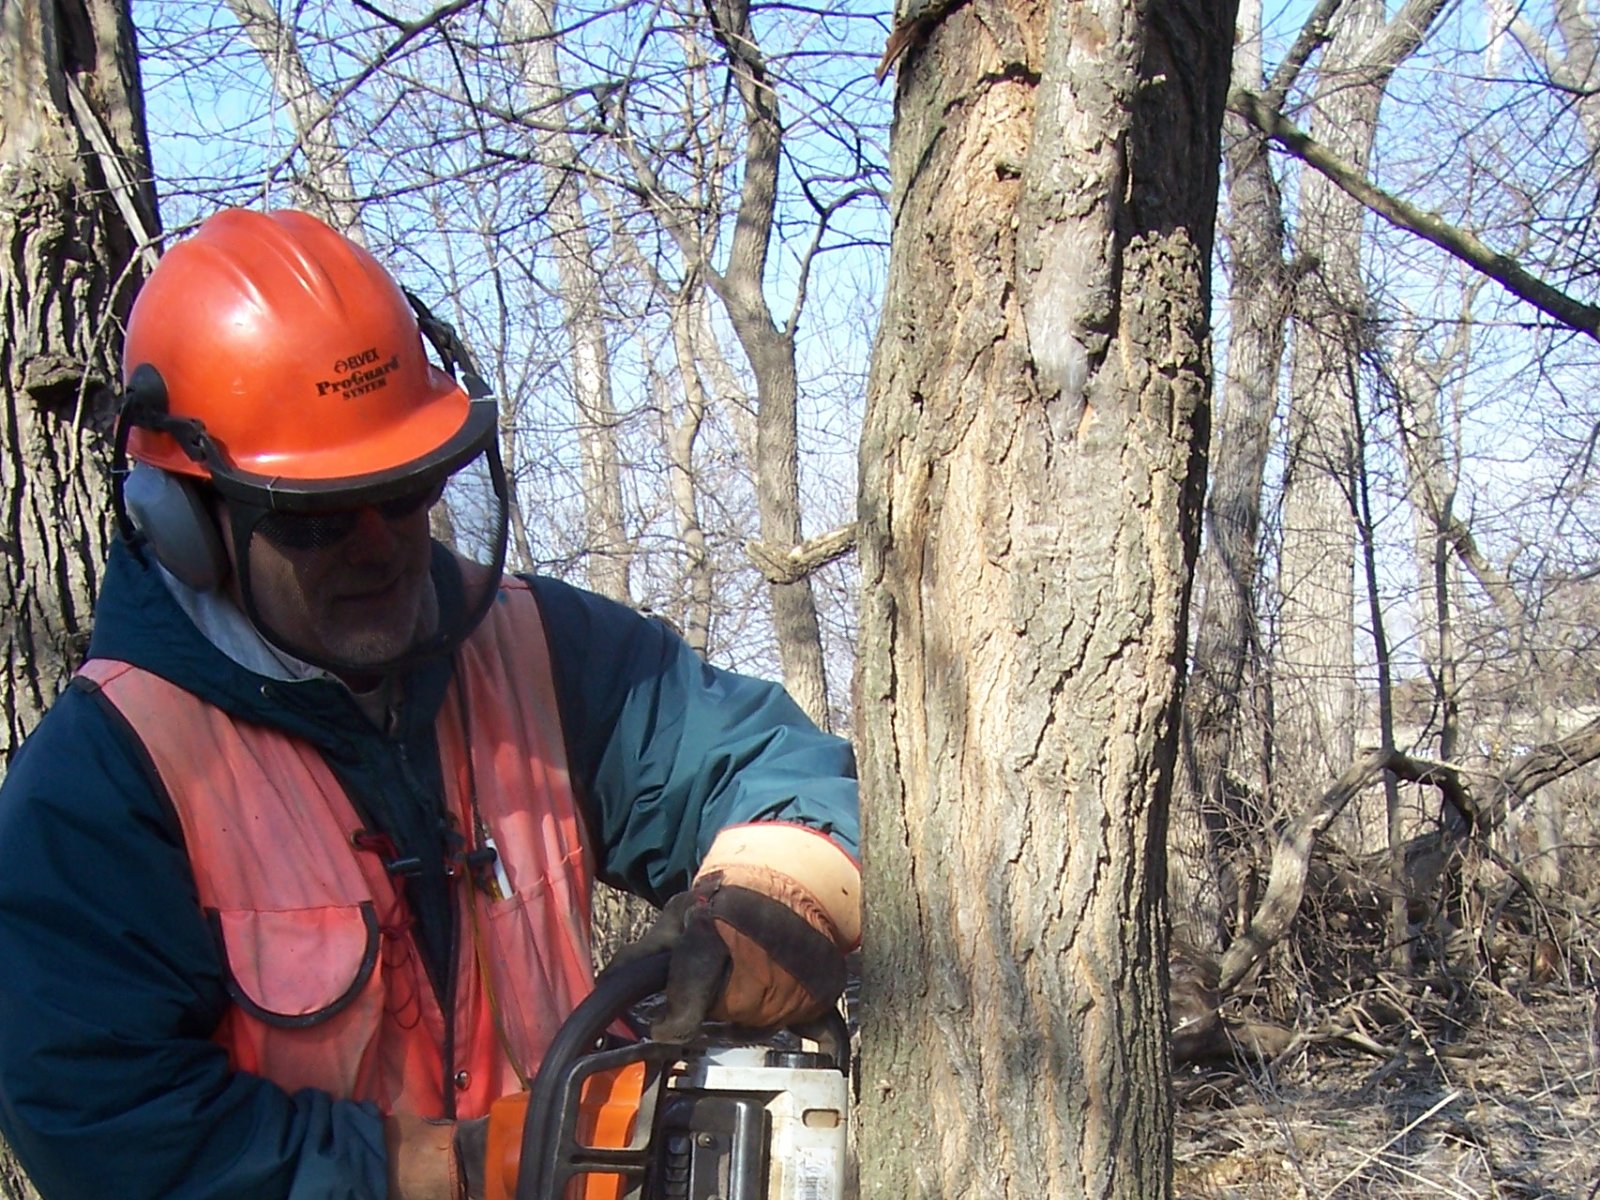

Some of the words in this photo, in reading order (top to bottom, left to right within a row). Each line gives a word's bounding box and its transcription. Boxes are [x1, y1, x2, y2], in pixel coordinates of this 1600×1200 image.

[347, 348, 379, 369] ELVEX
[315, 356, 399, 397] ProGuard
[342, 377, 387, 401] SYSTEM
